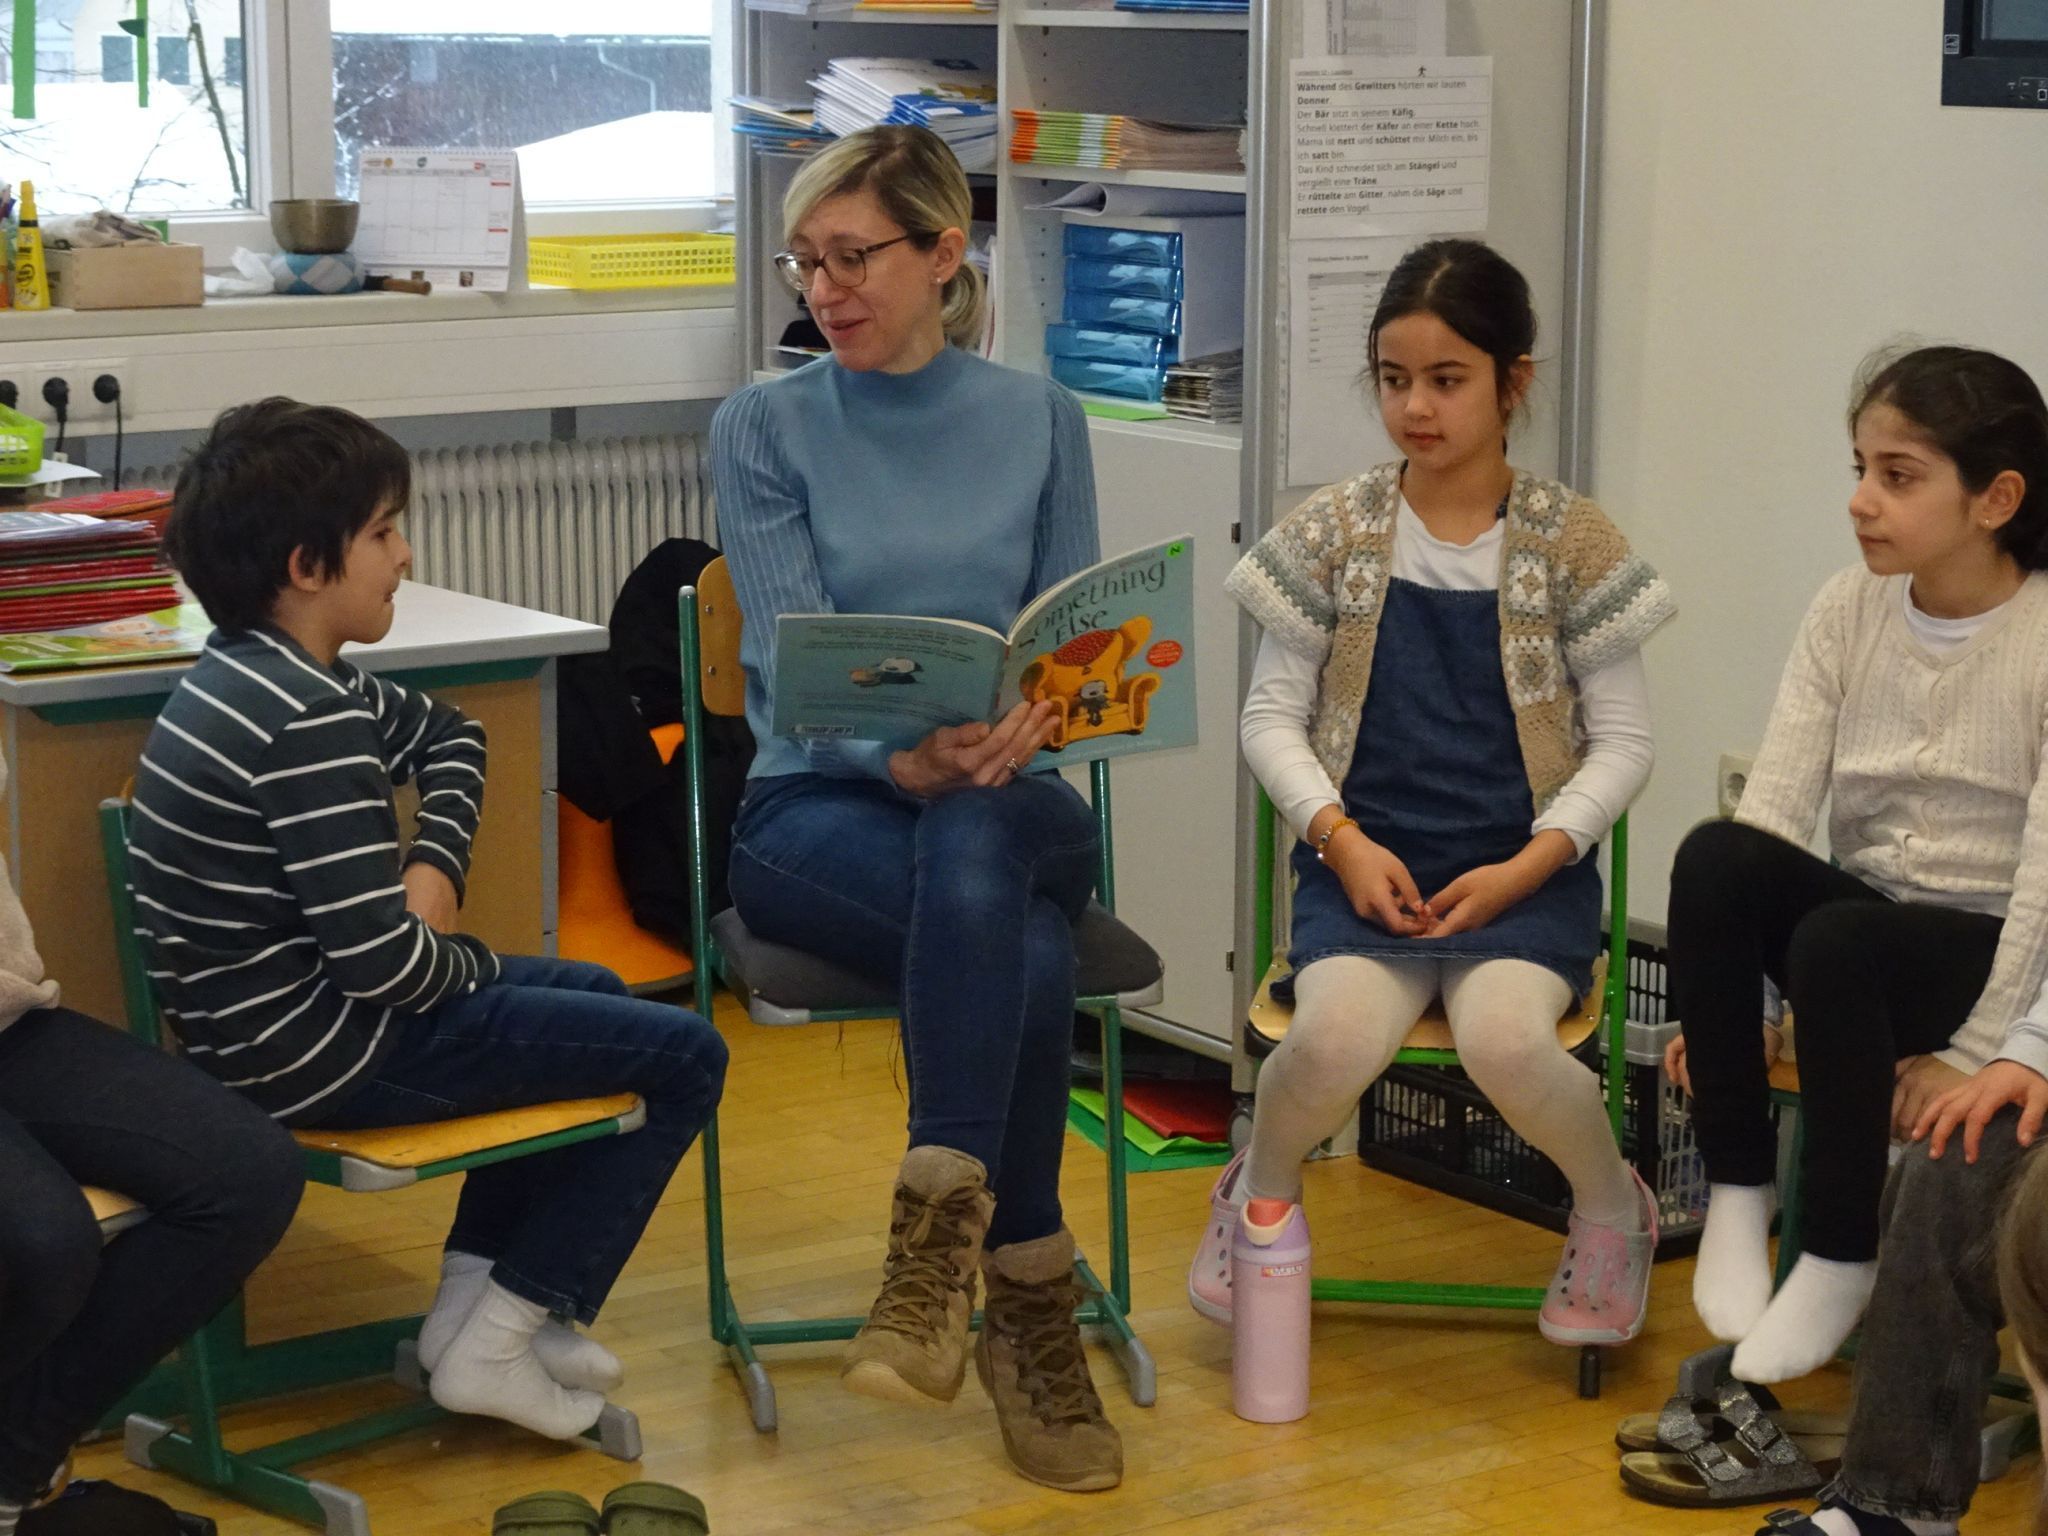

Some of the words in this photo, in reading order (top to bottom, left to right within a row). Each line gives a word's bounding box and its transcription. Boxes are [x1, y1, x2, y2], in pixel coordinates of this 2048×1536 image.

[1297, 82, 1336, 91] Während
[1354, 81, 1396, 90] Gewitters
[1315, 109, 1330, 118] Bär
[1376, 121, 1399, 130] Käfer
[1435, 120, 1458, 129] Kette
[1337, 137, 1356, 145] nett
[1375, 134, 1411, 144] schüttet
[1312, 151, 1330, 159] satt
[1408, 160, 1440, 173] Stängel
[1308, 191, 1343, 201] rüttelte
[1426, 187, 1446, 199] Säge
[1297, 206, 1328, 215] rettete
